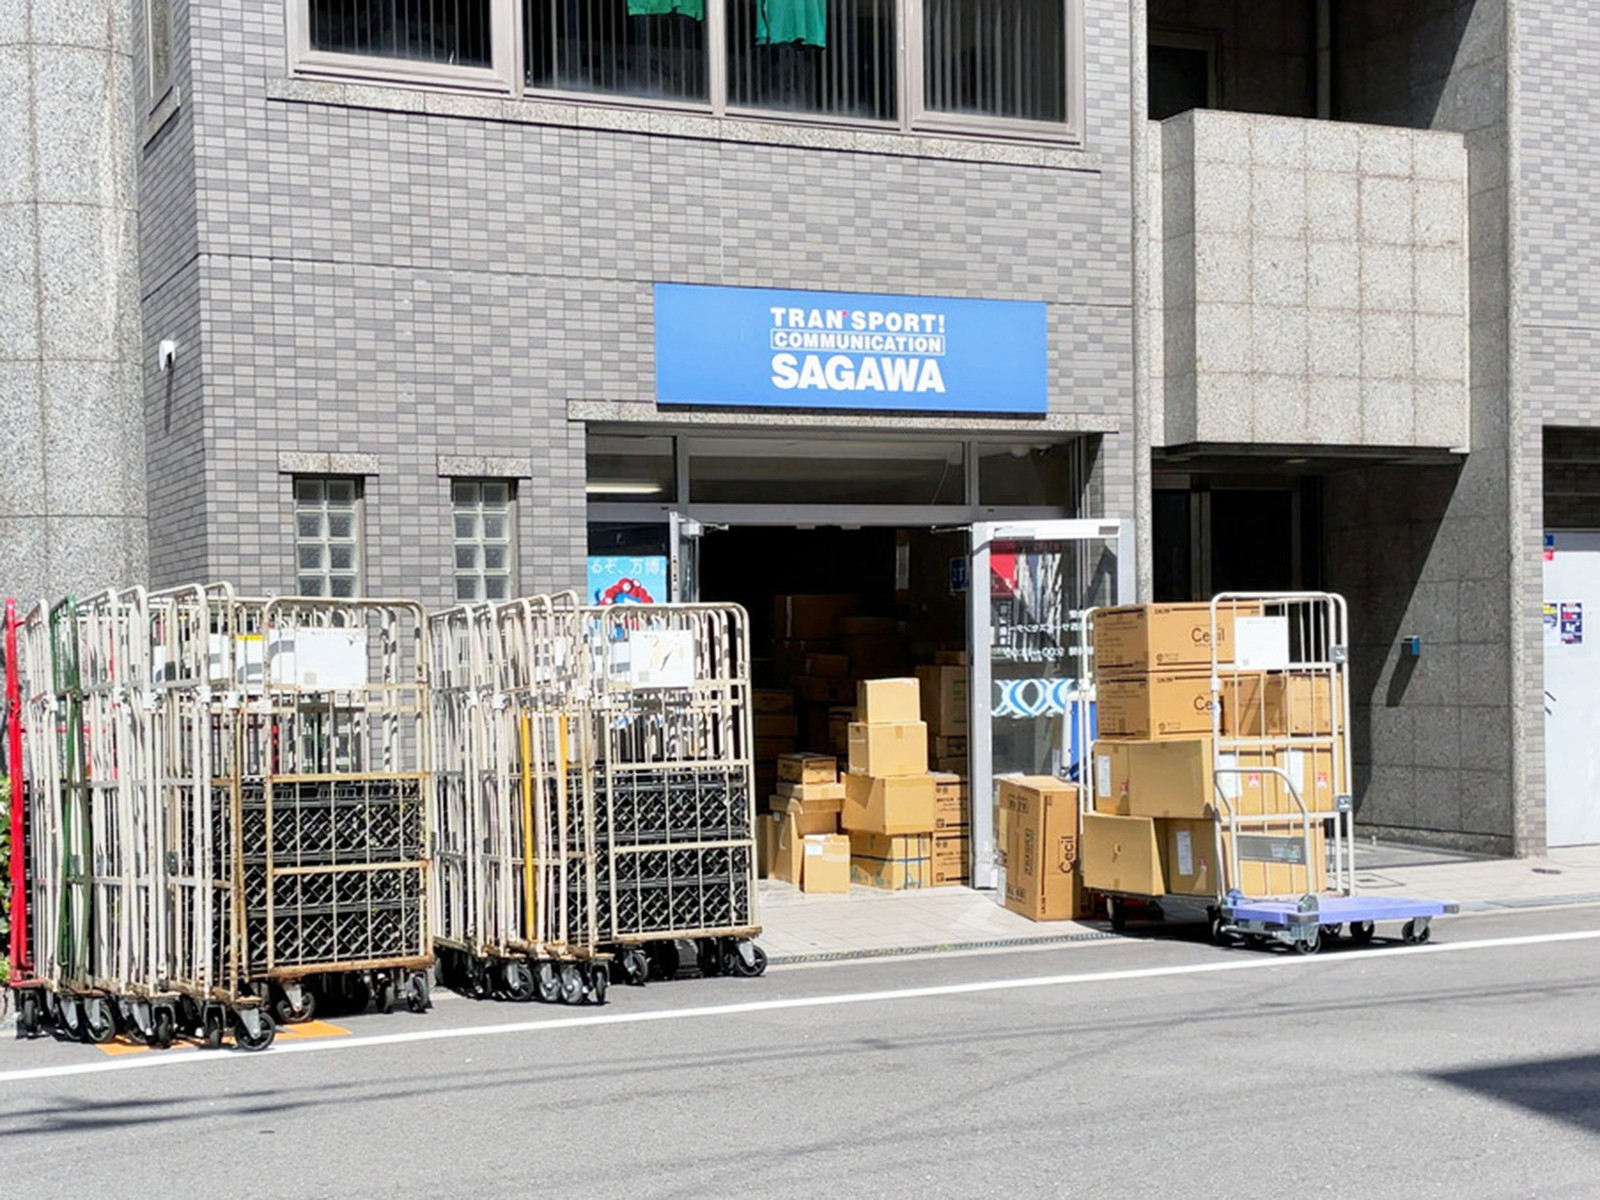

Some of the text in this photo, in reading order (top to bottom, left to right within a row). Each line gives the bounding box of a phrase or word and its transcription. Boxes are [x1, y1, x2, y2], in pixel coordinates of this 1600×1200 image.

[774, 332, 941, 352] COMMUNICATION
[771, 353, 946, 393] SAGAWA
[1191, 627, 1225, 643] Ceil
[1059, 835, 1074, 874] Cecil
